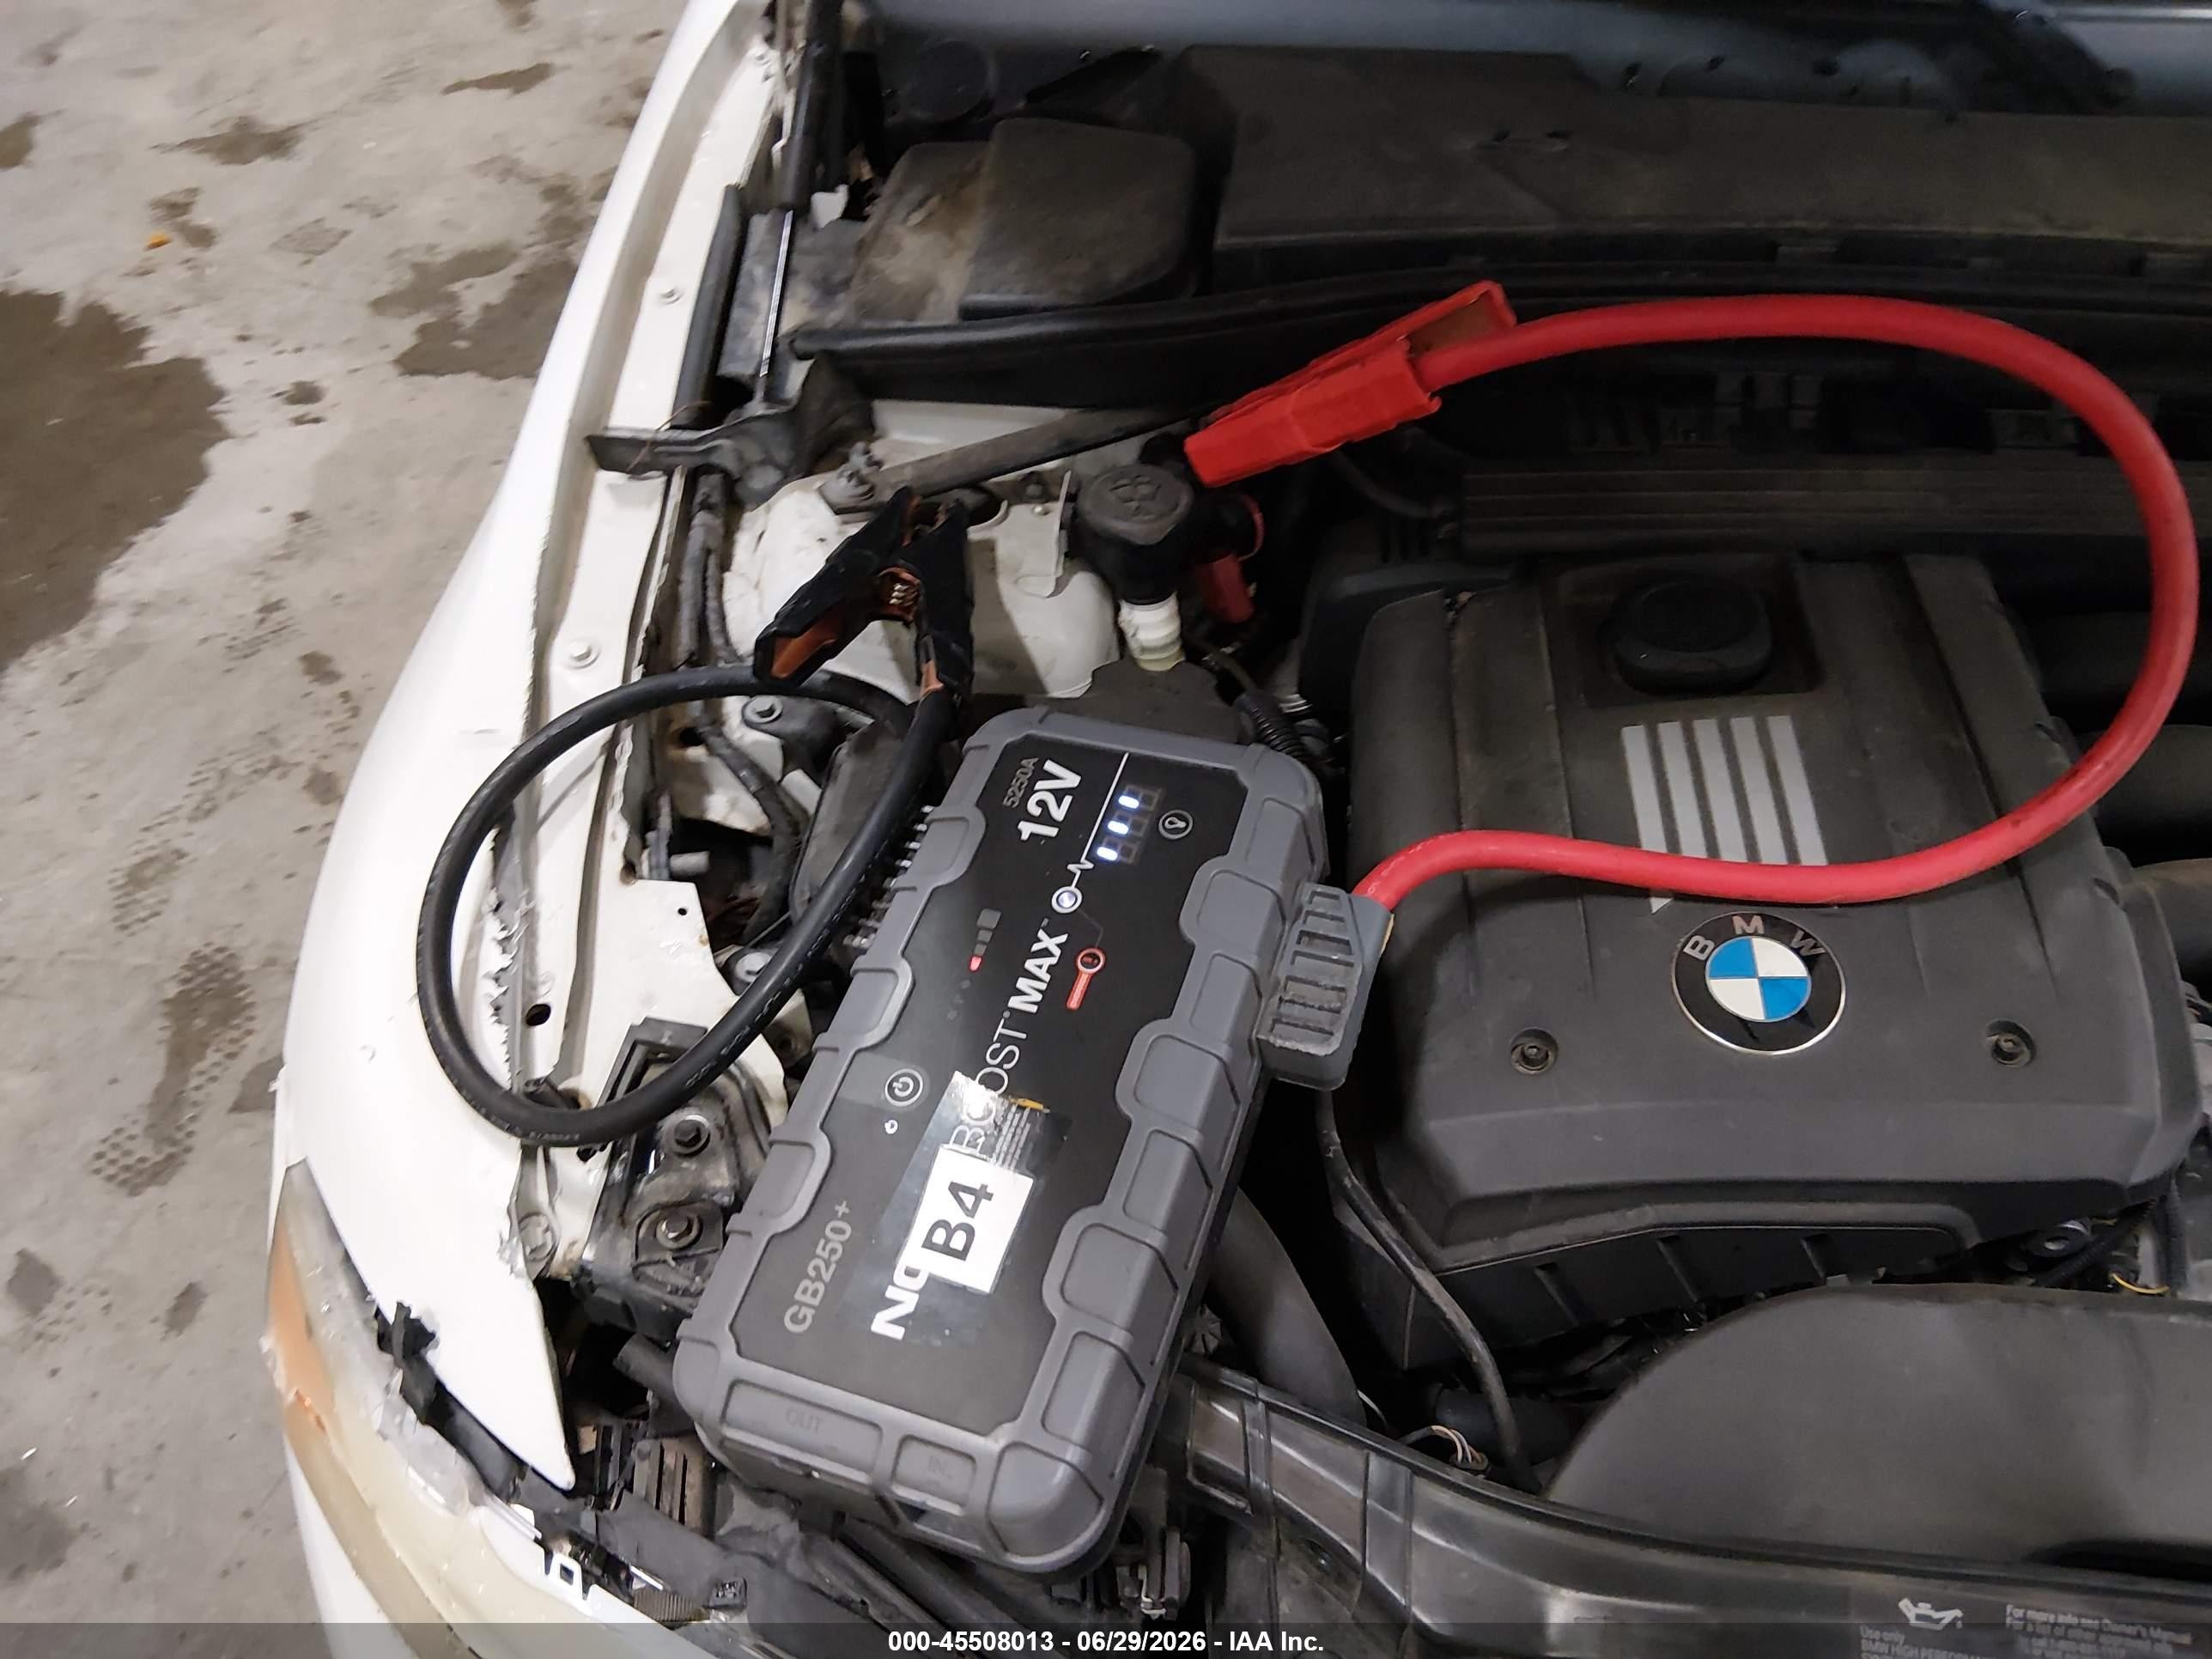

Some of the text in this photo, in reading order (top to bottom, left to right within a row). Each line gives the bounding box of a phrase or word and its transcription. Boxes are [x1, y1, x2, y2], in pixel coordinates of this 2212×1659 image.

[1003, 757, 1039, 809] 5250A
[1017, 759, 1083, 842] 12V
[1009, 933, 1069, 1015] MAX
[1682, 915, 1826, 961] BMW
[921, 1180, 995, 1262] B4
[782, 1200, 853, 1334] GB250+
